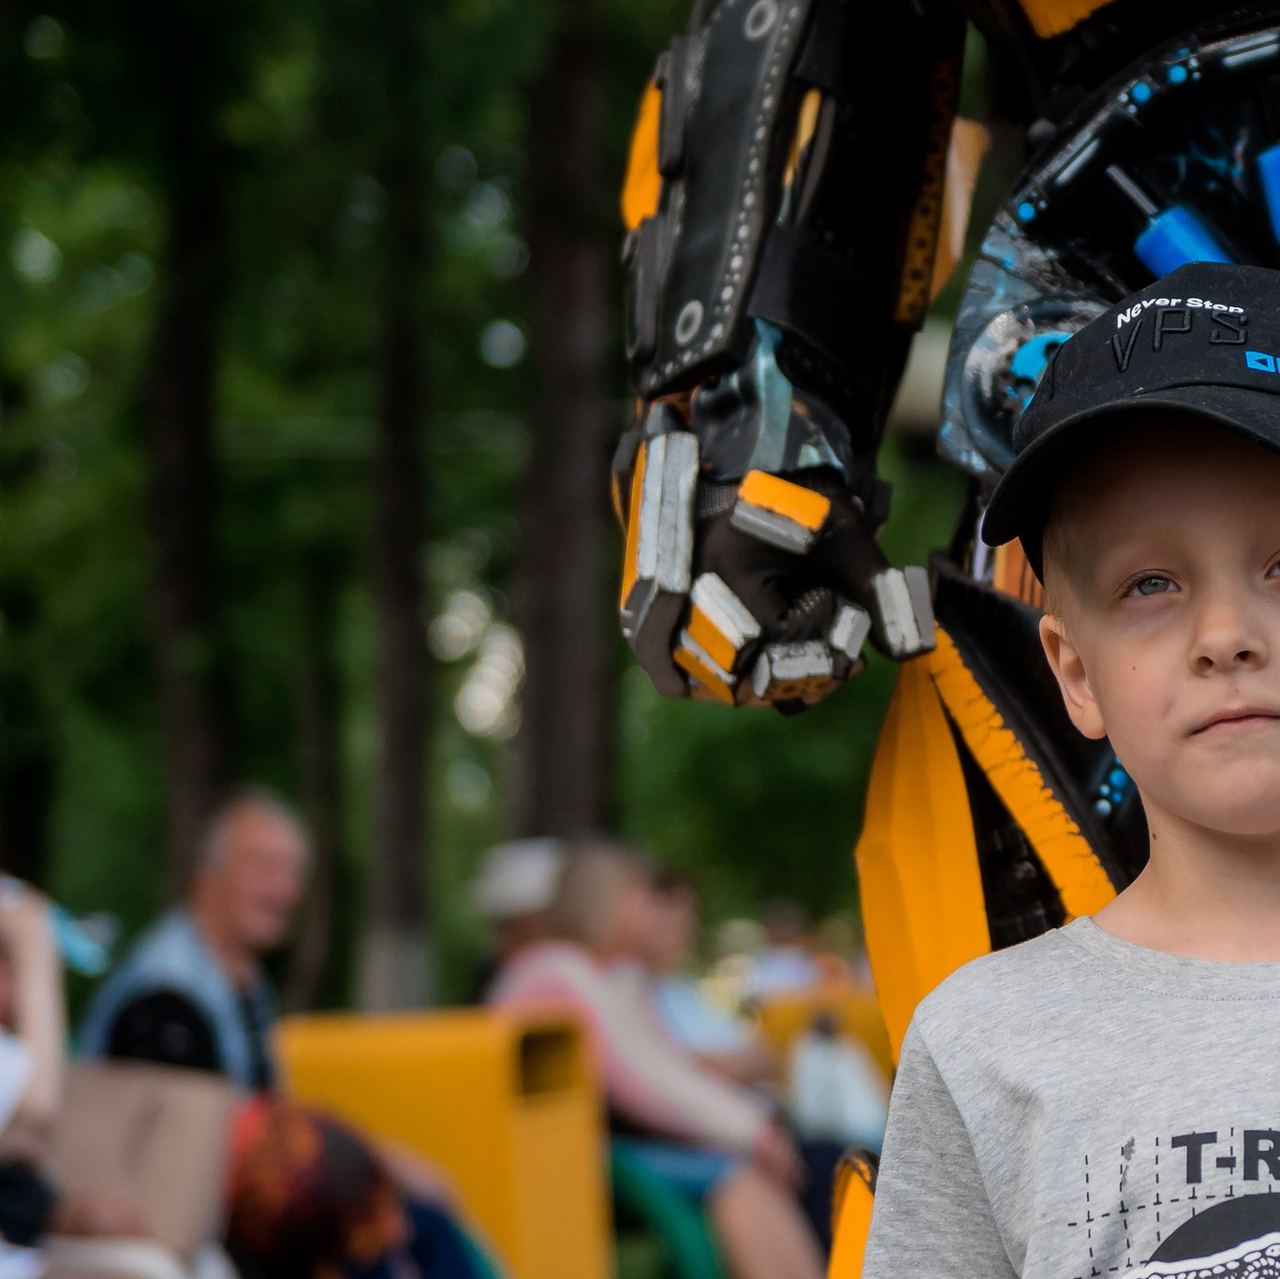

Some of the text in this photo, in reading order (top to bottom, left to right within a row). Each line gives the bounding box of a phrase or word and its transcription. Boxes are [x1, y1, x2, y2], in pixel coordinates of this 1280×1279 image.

[1116, 297, 1244, 328] Never Stop
[1112, 308, 1247, 373] VPS
